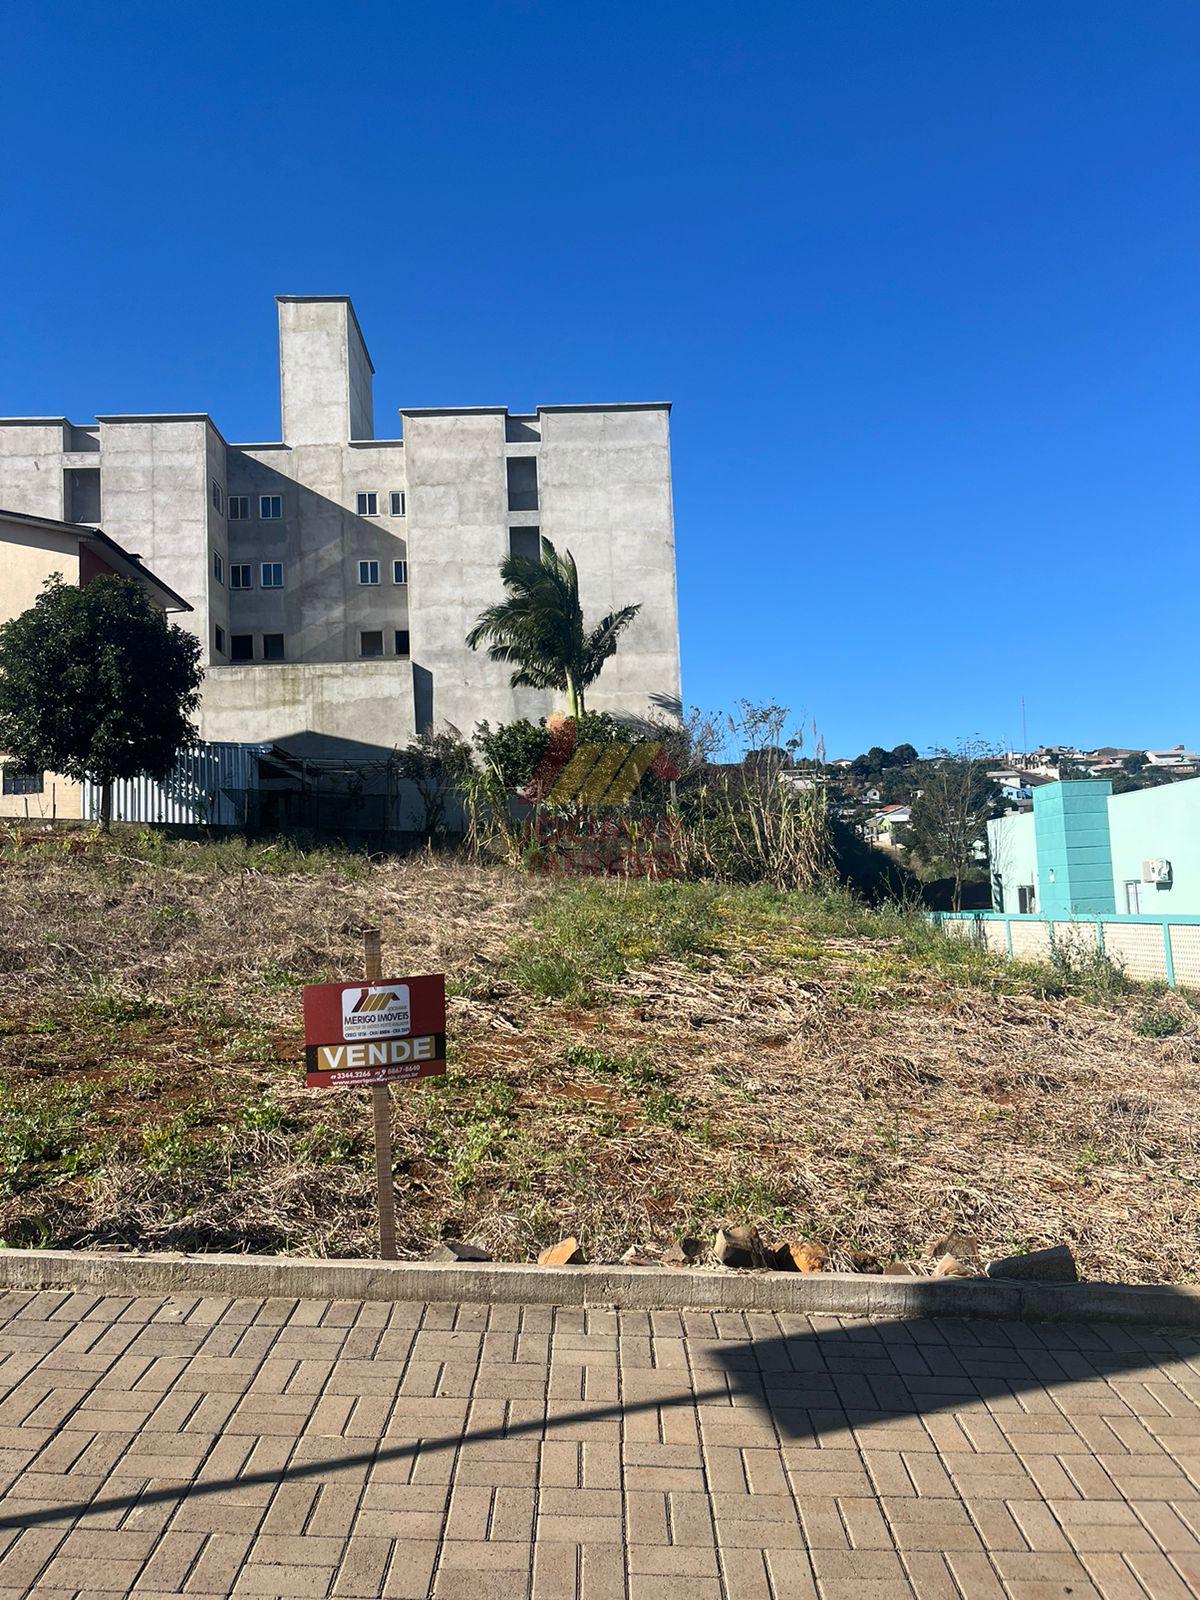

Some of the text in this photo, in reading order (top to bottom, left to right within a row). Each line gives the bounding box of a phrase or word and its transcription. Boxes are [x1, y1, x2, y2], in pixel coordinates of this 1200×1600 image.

[344, 1011, 409, 1025] MERIGO IMÓVEIS
[322, 1037, 432, 1069] VENDE
